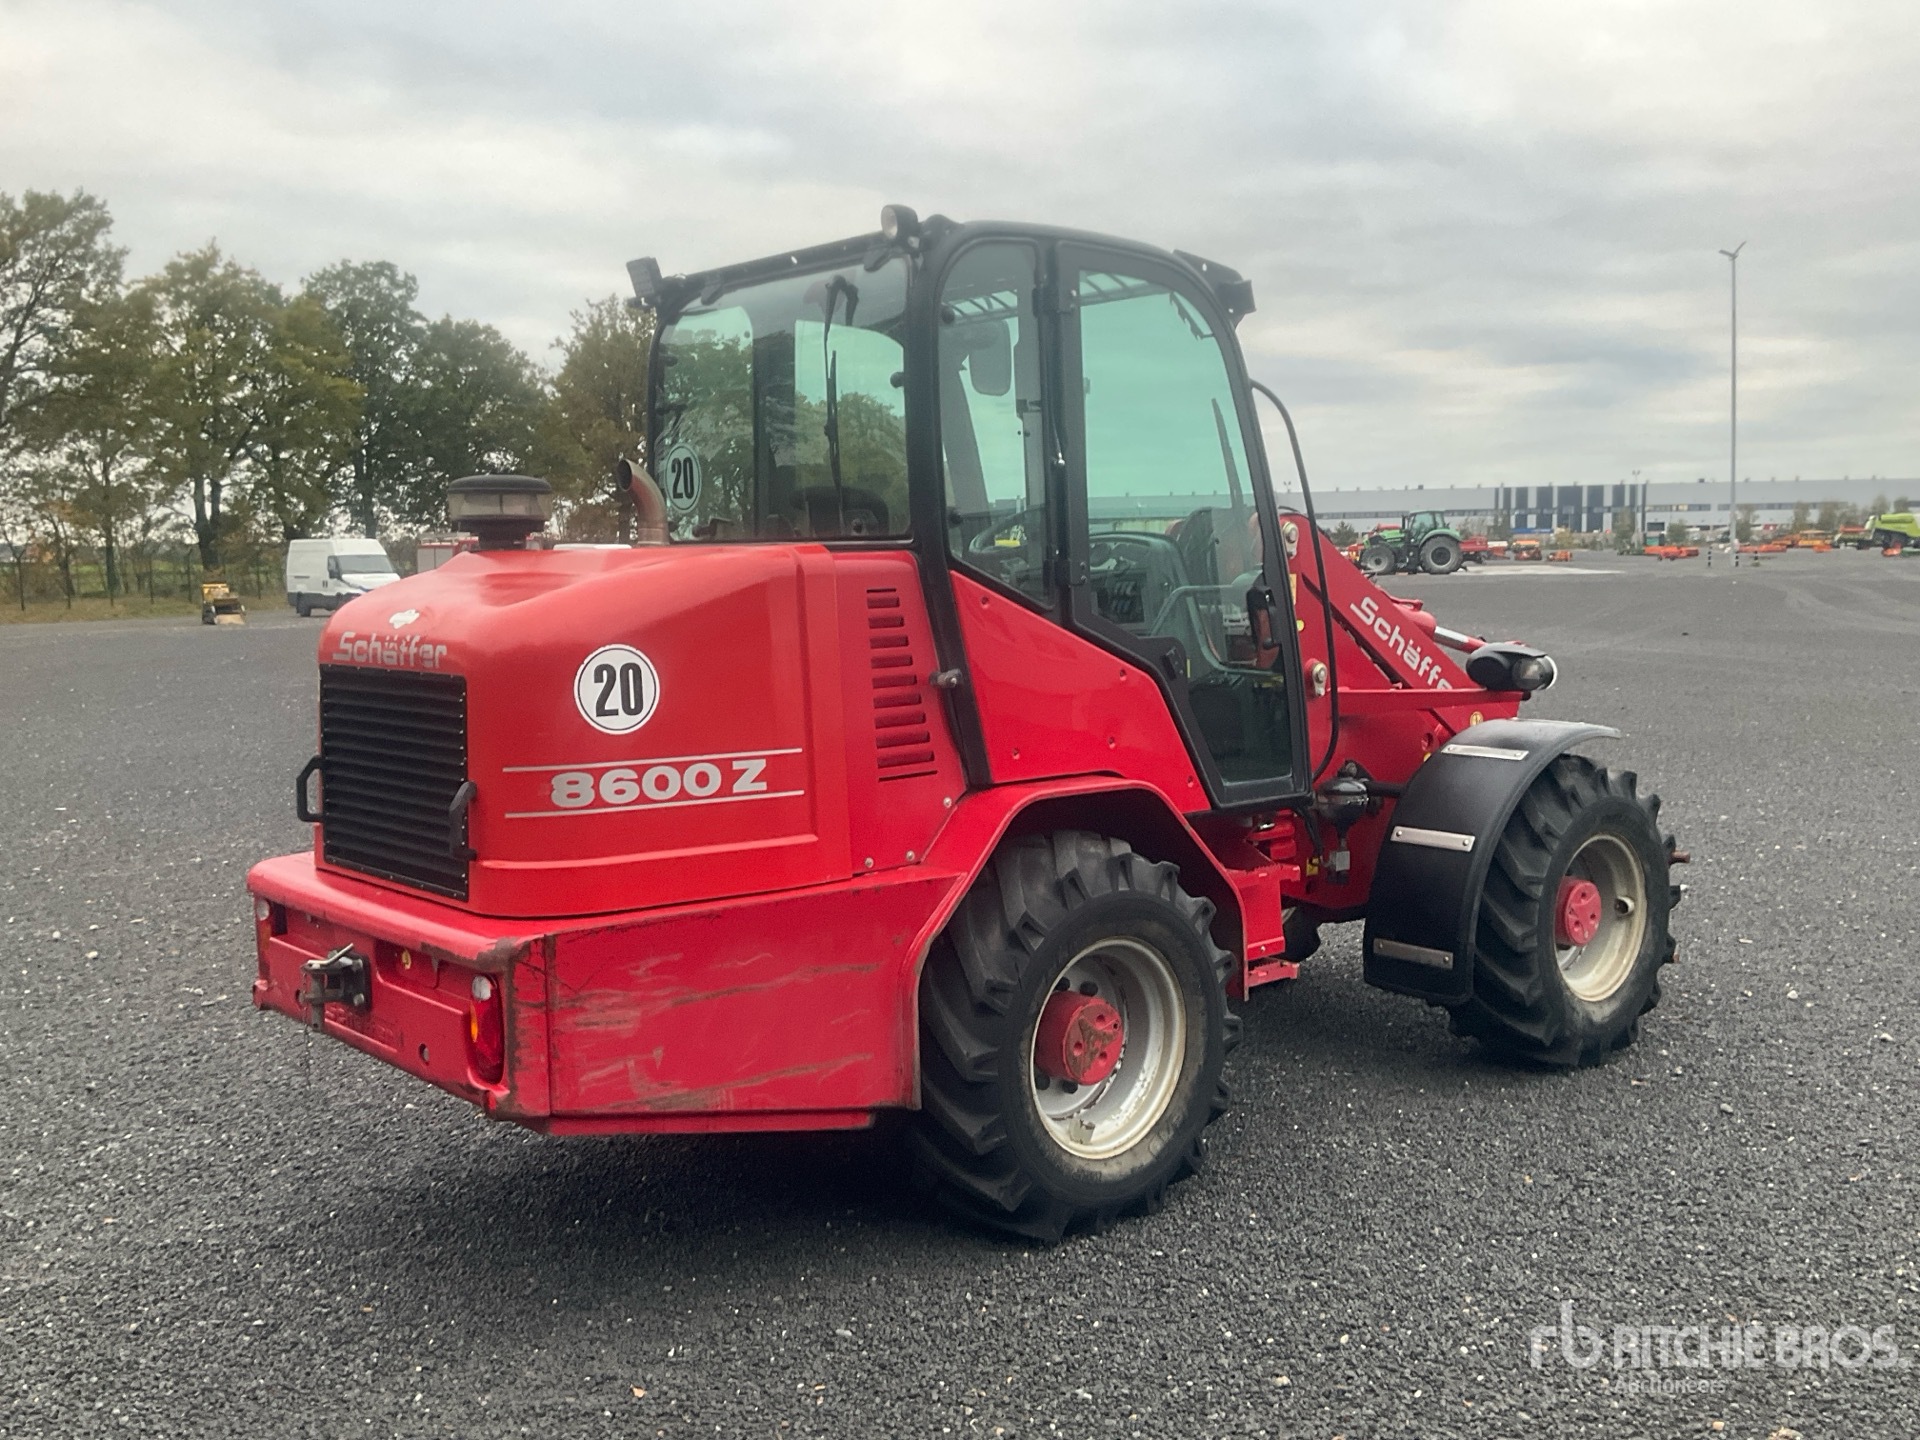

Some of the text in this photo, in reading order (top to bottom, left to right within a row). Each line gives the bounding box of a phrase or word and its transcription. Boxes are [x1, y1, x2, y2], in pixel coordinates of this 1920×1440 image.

[671, 456, 695, 500] 20
[332, 631, 448, 669] Schäffer
[593, 662, 644, 718] 20
[551, 758, 768, 808] 8600 Z
